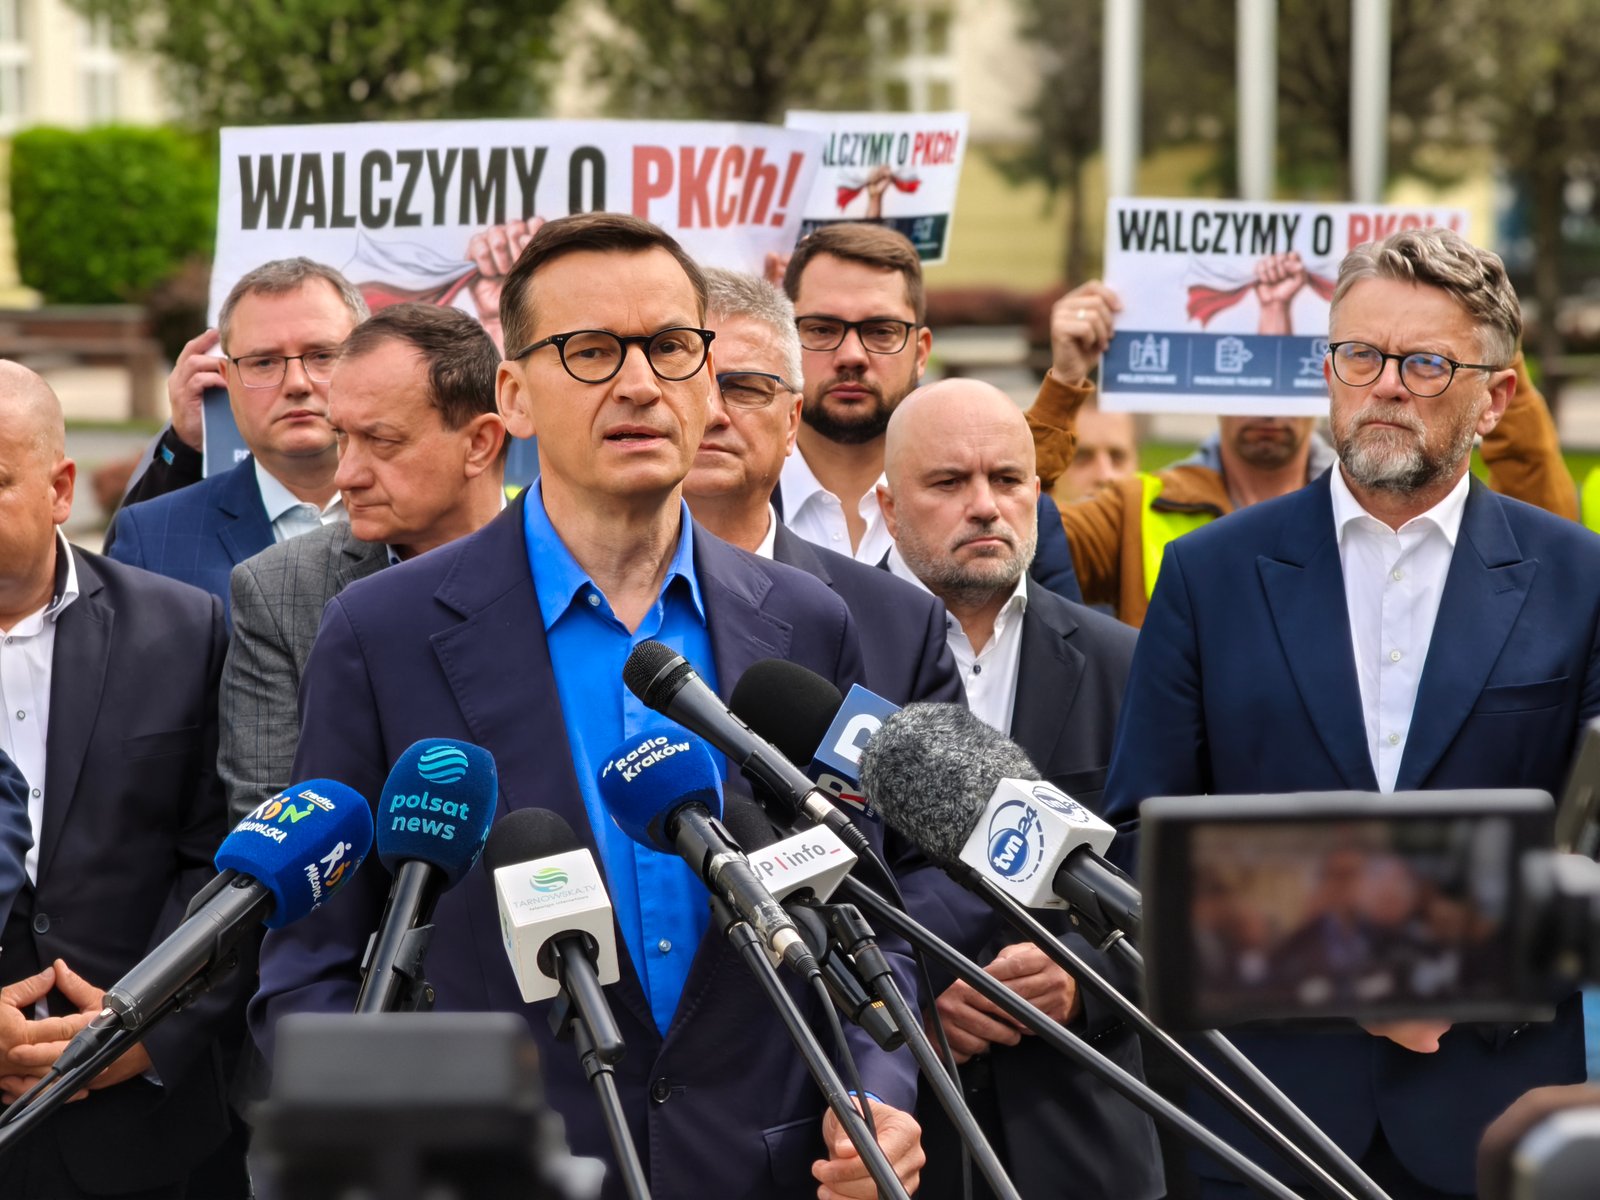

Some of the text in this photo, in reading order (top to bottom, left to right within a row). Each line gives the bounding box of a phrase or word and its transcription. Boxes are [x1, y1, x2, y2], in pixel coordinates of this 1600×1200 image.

[823, 131, 895, 167] LCZYMY
[898, 132, 909, 165] O
[238, 144, 807, 230] WALCZYMY O PKCh!
[1118, 209, 1301, 256] WALCZYMY
[1312, 213, 1333, 256] O
[615, 736, 668, 771] Radio
[622, 741, 690, 782] Kraków
[390, 791, 470, 821] polsat
[391, 815, 456, 841] news
